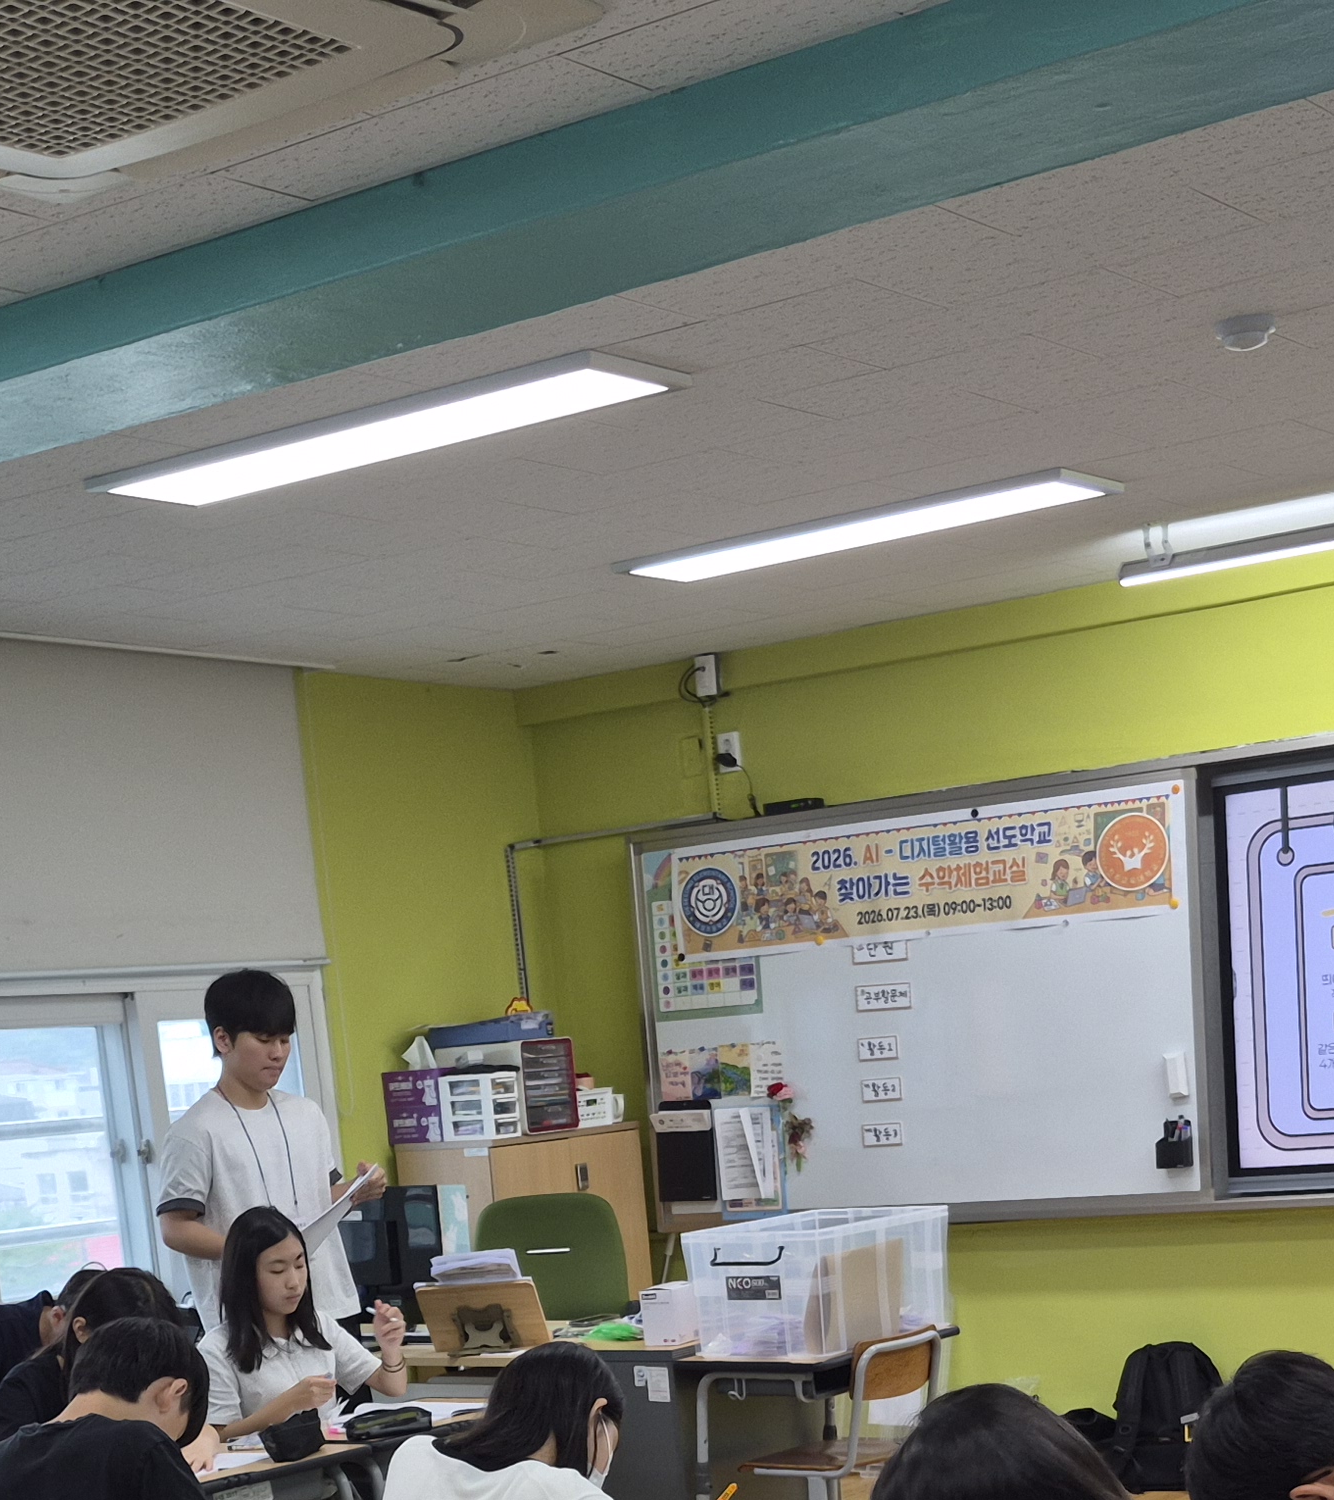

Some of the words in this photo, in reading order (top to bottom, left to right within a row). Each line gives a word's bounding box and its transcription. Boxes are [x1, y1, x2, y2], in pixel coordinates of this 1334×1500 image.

[811, 847, 857, 872] 2026.
[863, 844, 879, 865] AI
[899, 830, 980, 861] 디지털활용
[985, 821, 1053, 851] 선도학교
[837, 872, 910, 903] 찾아가는
[918, 856, 1027, 894] 수학체험교실
[857, 902, 941, 925] 2026.07.23.(목)
[943, 895, 1012, 917] 09:00~13:00
